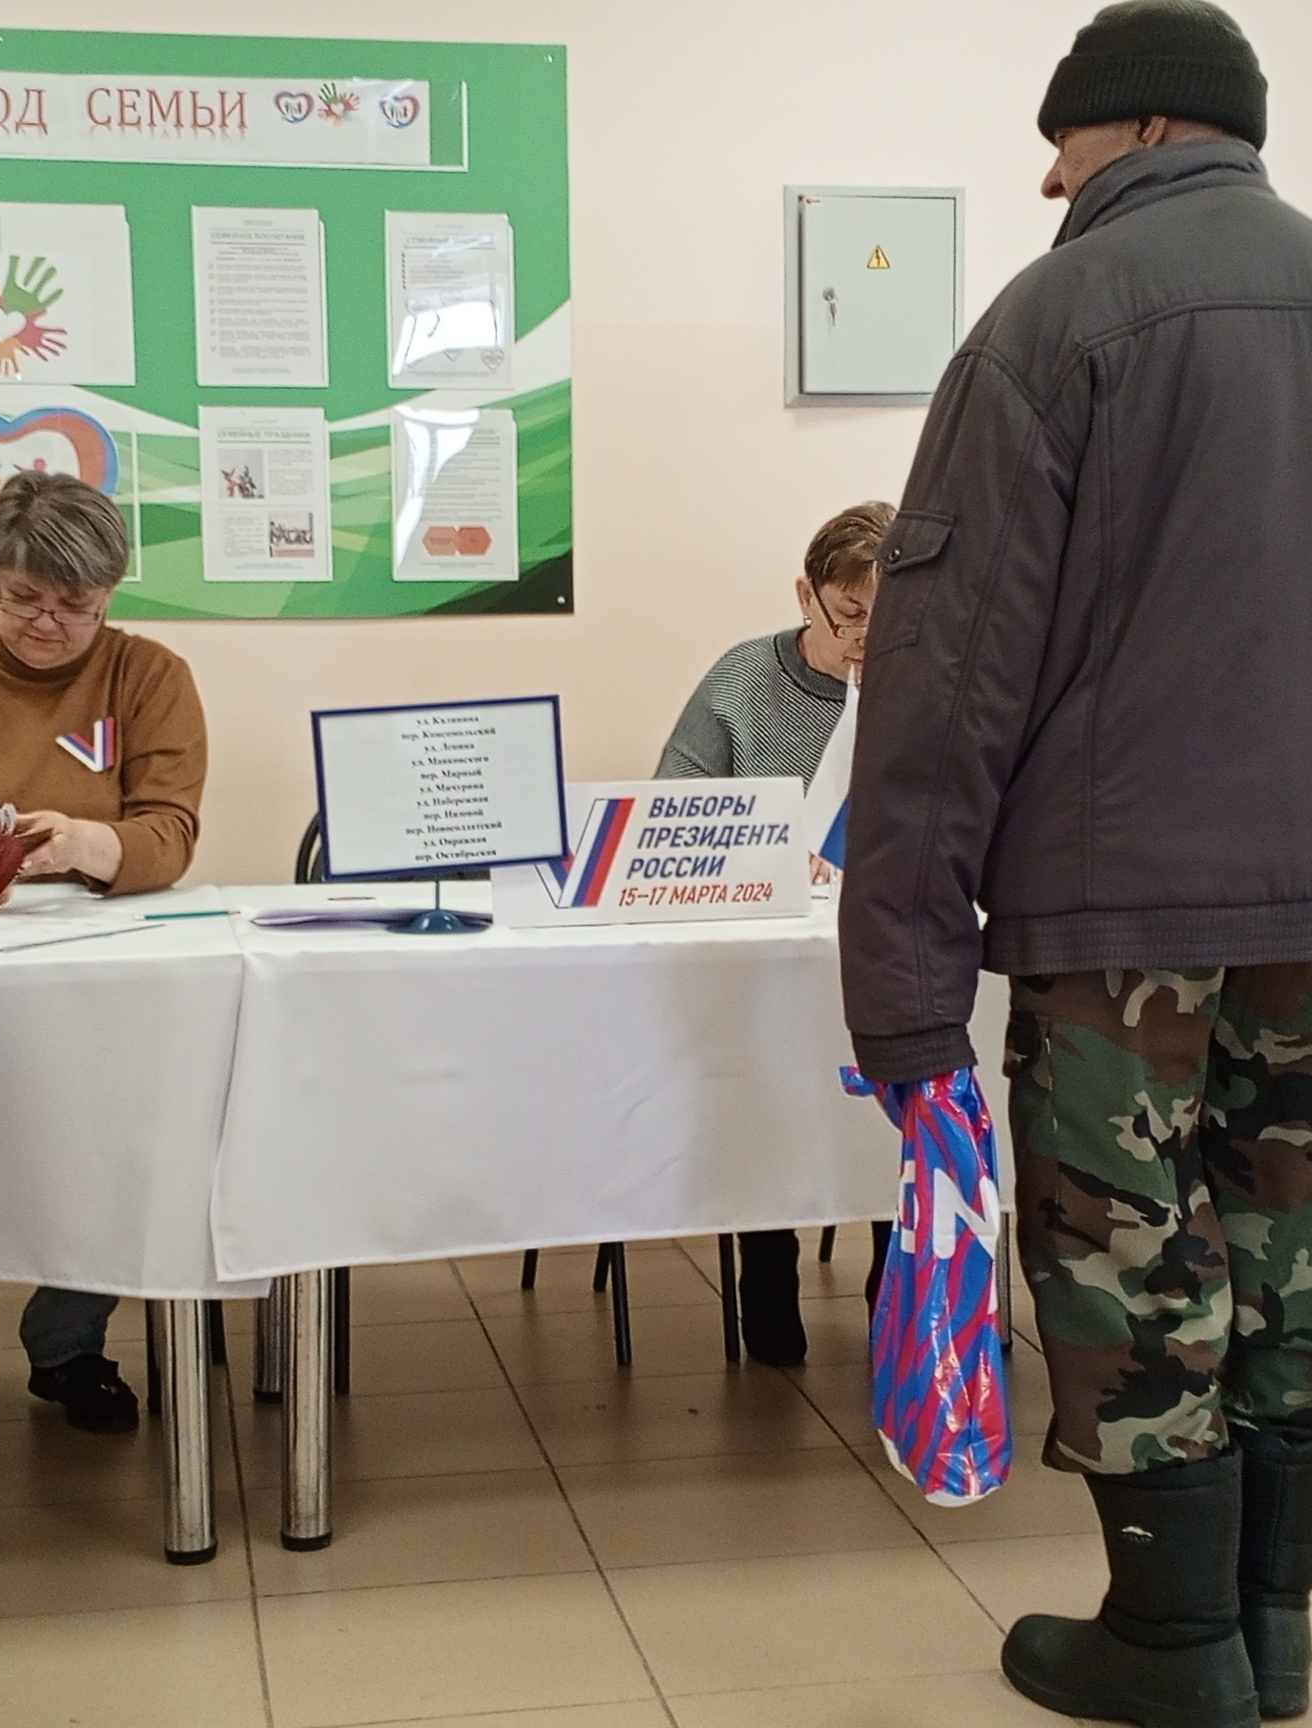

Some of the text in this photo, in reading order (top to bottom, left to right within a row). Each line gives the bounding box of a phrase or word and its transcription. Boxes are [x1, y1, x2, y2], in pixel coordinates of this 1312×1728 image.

[87, 86, 248, 128] СЕМЬИ
[416, 715, 480, 727] ул. Калинина
[401, 727, 496, 741] пер. Комсомольский
[424, 742, 475, 754] ул. Ленина
[411, 756, 489, 769] ул. Маяковского
[420, 768, 482, 781] пер. Мирный
[419, 783, 485, 795] ул. Мичурина
[416, 796, 489, 809] ул. Набережная
[647, 795, 757, 819] ВЫБОРЫ
[423, 813, 442, 821] пер.
[405, 827, 425, 836] пер.
[636, 823, 791, 850] ПРЕЗИДЕНТА
[423, 840, 436, 849] ул.
[414, 854, 433, 862] пер.
[626, 855, 728, 881] РОССИИ
[668, 883, 729, 906] МАРТА
[731, 881, 775, 904] 2024
